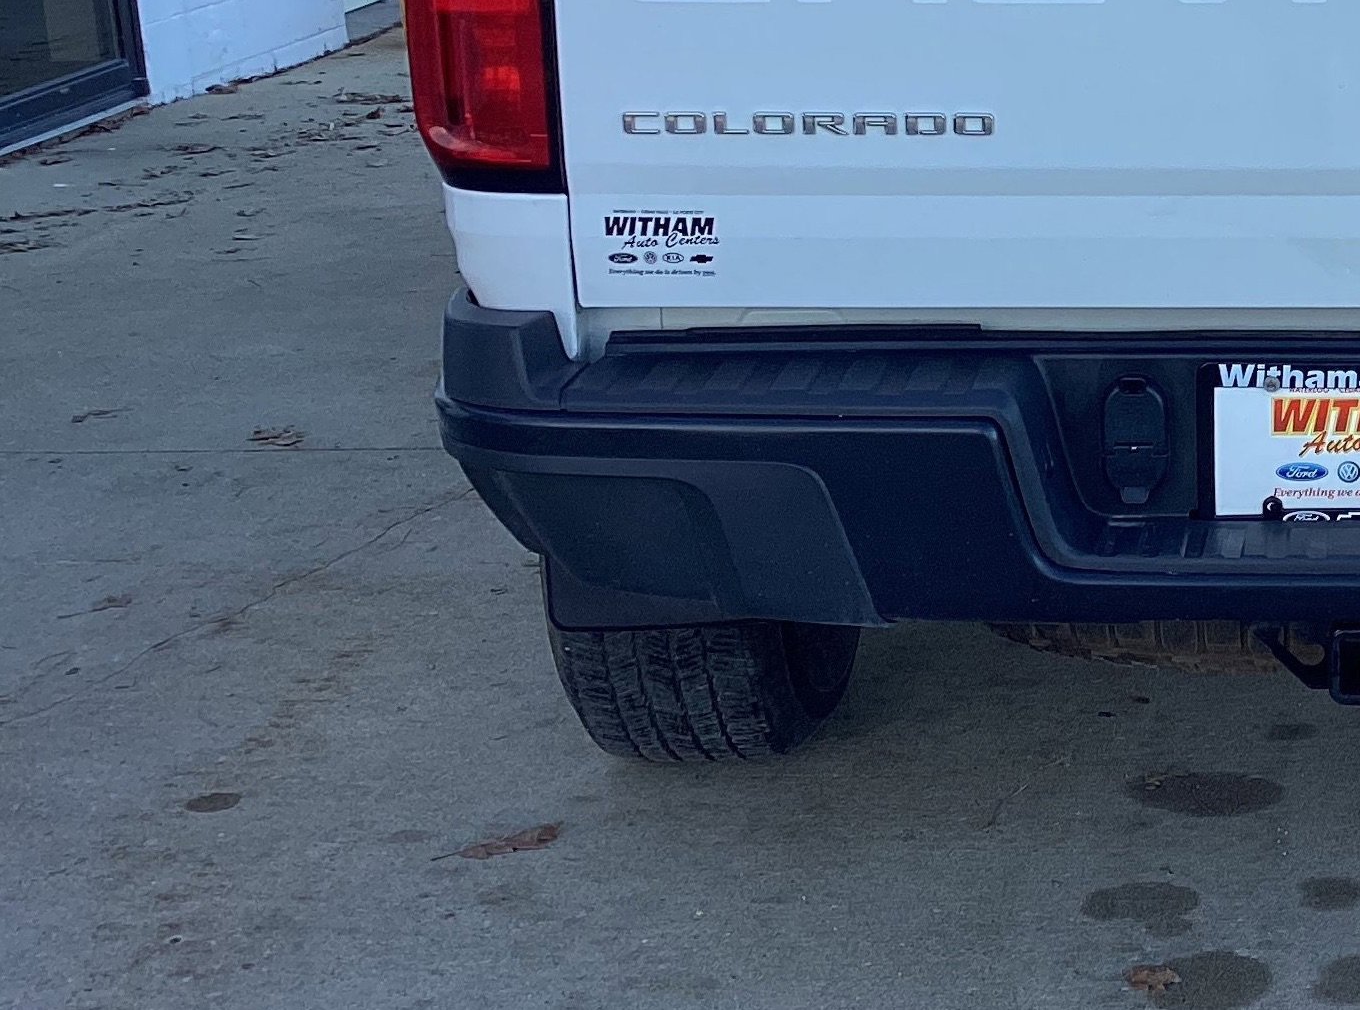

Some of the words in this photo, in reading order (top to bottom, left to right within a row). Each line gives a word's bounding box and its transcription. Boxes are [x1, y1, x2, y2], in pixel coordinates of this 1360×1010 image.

[622, 111, 995, 137] COLORADO
[604, 216, 715, 237] WITHAM
[621, 235, 658, 250] Auto
[665, 232, 720, 248] Centers
[1286, 464, 1318, 479] Ford
[1273, 487, 1335, 499] Everything
